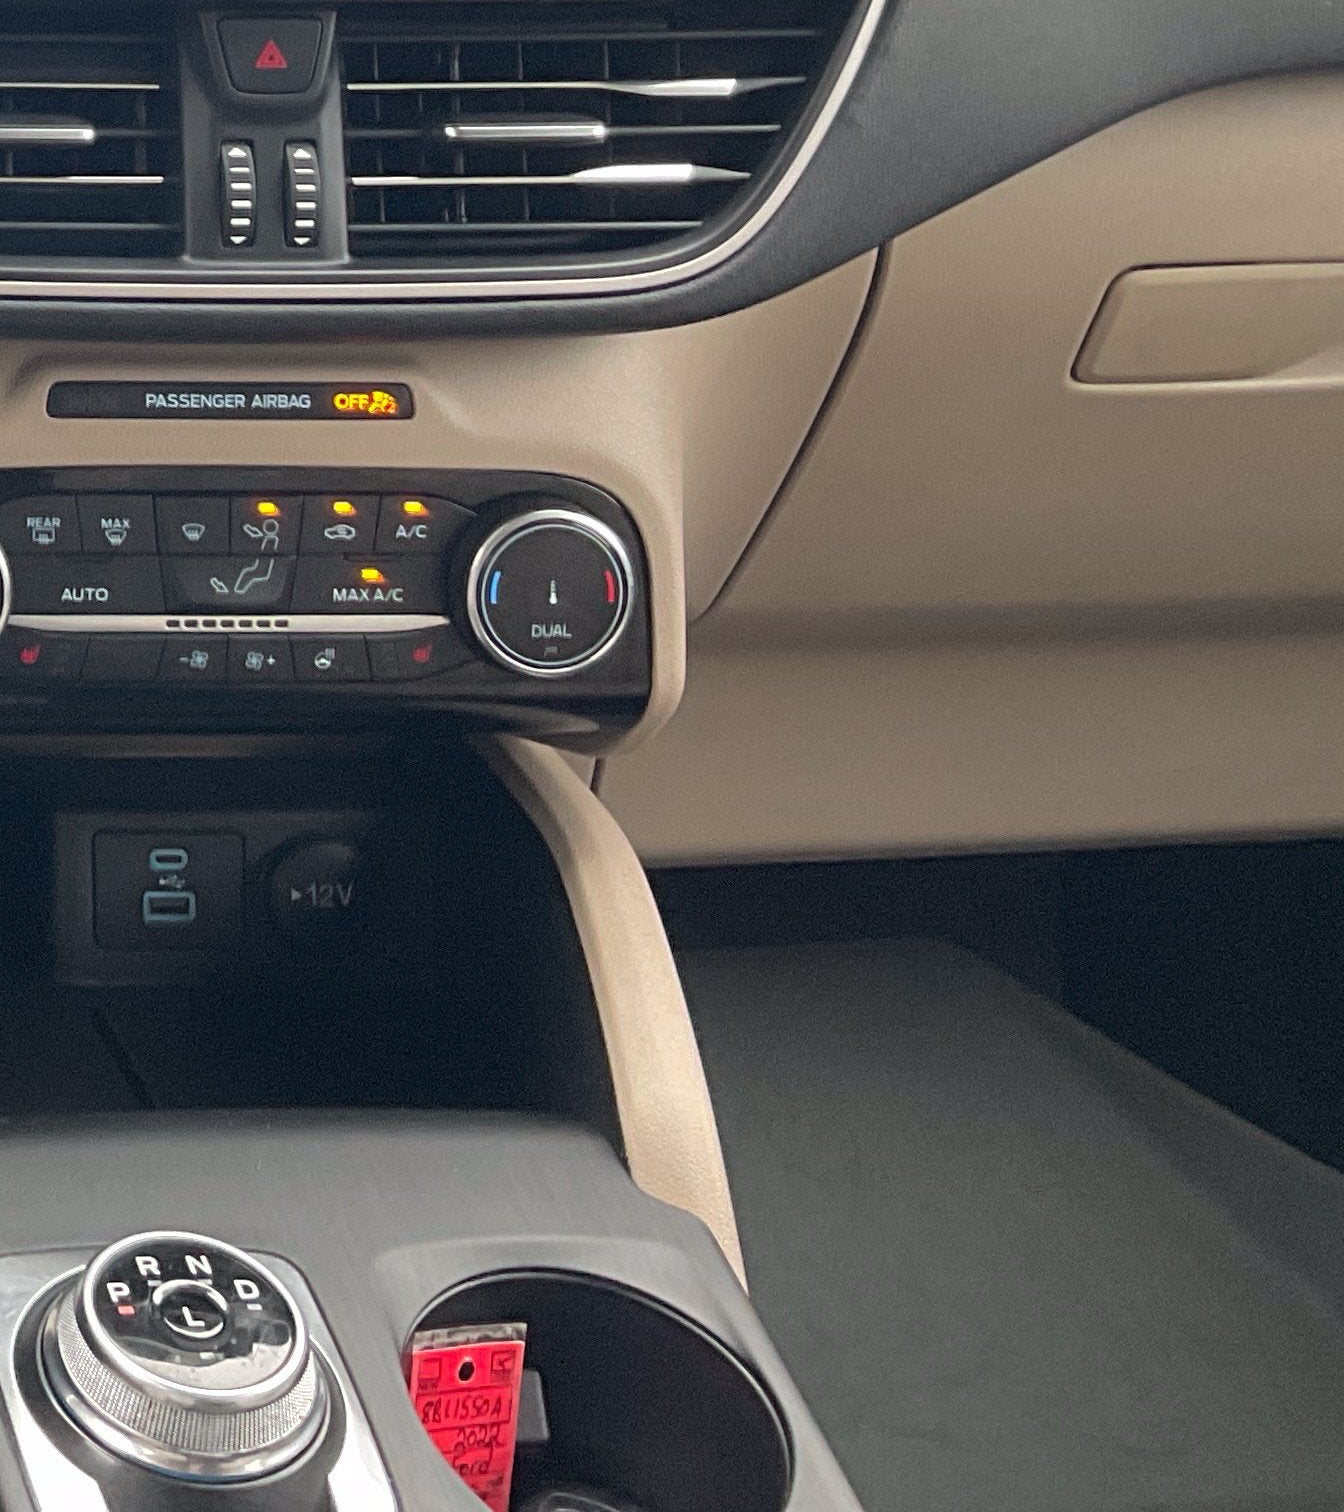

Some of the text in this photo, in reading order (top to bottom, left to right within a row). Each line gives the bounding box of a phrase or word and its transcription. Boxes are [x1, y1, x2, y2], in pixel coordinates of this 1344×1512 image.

[144, 392, 369, 411] PASSENGER AIRBAG OFF
[26, 516, 61, 529] REAR
[100, 517, 131, 530] MAX
[395, 524, 428, 539] A/C
[60, 587, 110, 603] AUTO
[332, 587, 404, 603] MAX A/C
[530, 623, 573, 639] DUAL
[310, 880, 355, 908] 12V
[106, 1254, 260, 1303] P R N D
[181, 1305, 206, 1327] L
